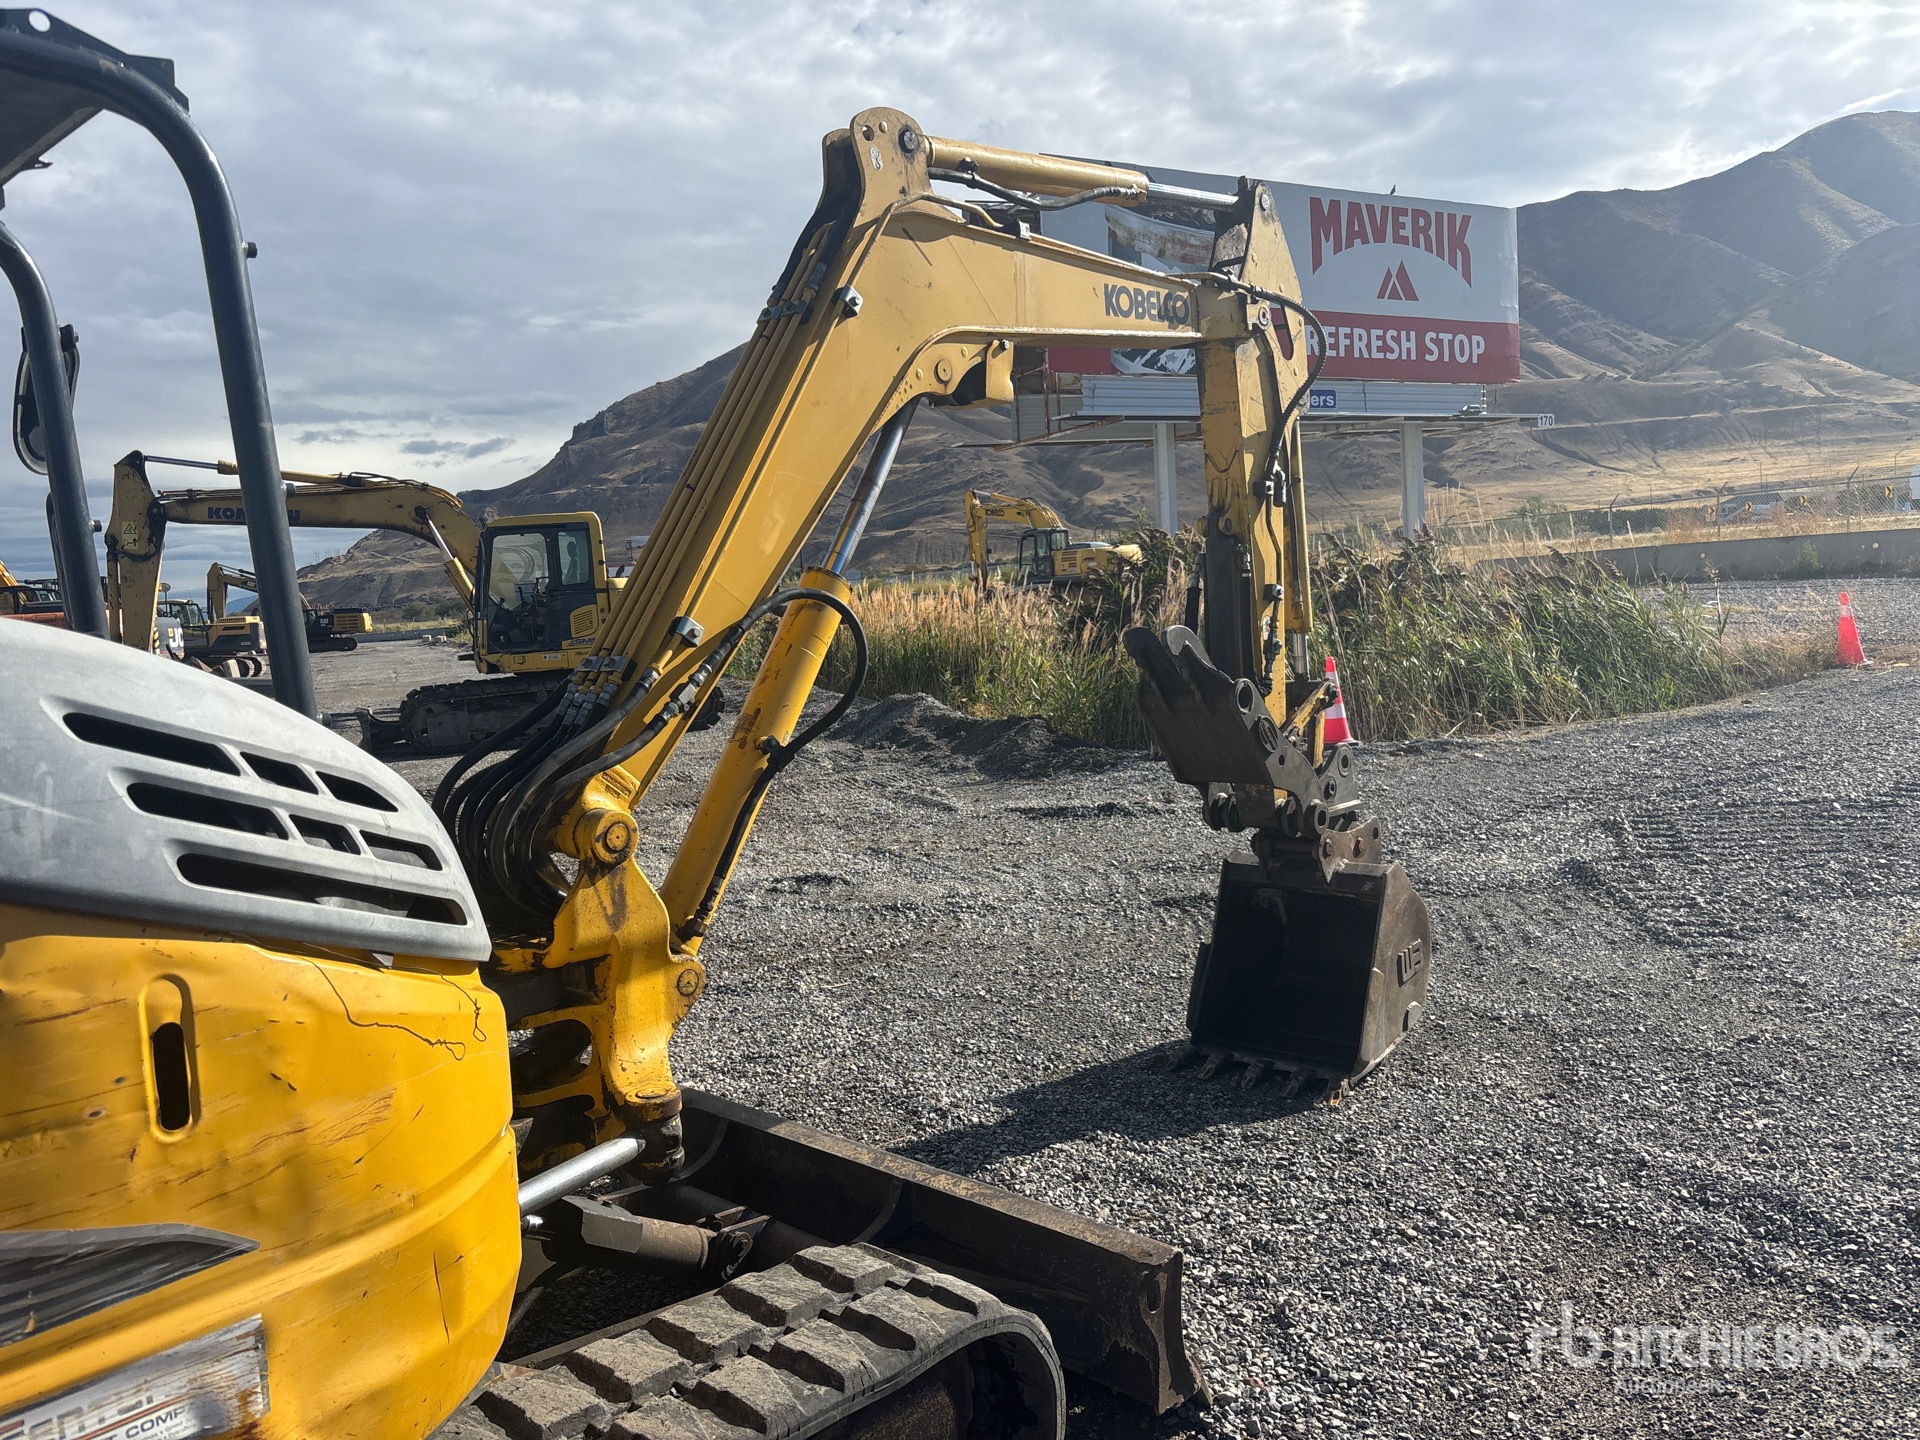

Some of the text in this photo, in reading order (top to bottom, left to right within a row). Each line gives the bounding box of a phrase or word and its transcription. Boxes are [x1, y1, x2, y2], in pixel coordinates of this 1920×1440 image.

[1309, 196, 1472, 288] MAVERIK
[1103, 283, 1189, 325] KOBELCO
[1424, 331, 1485, 364] STOP
[1310, 395, 1334, 406] ers
[1539, 415, 1553, 426] 170
